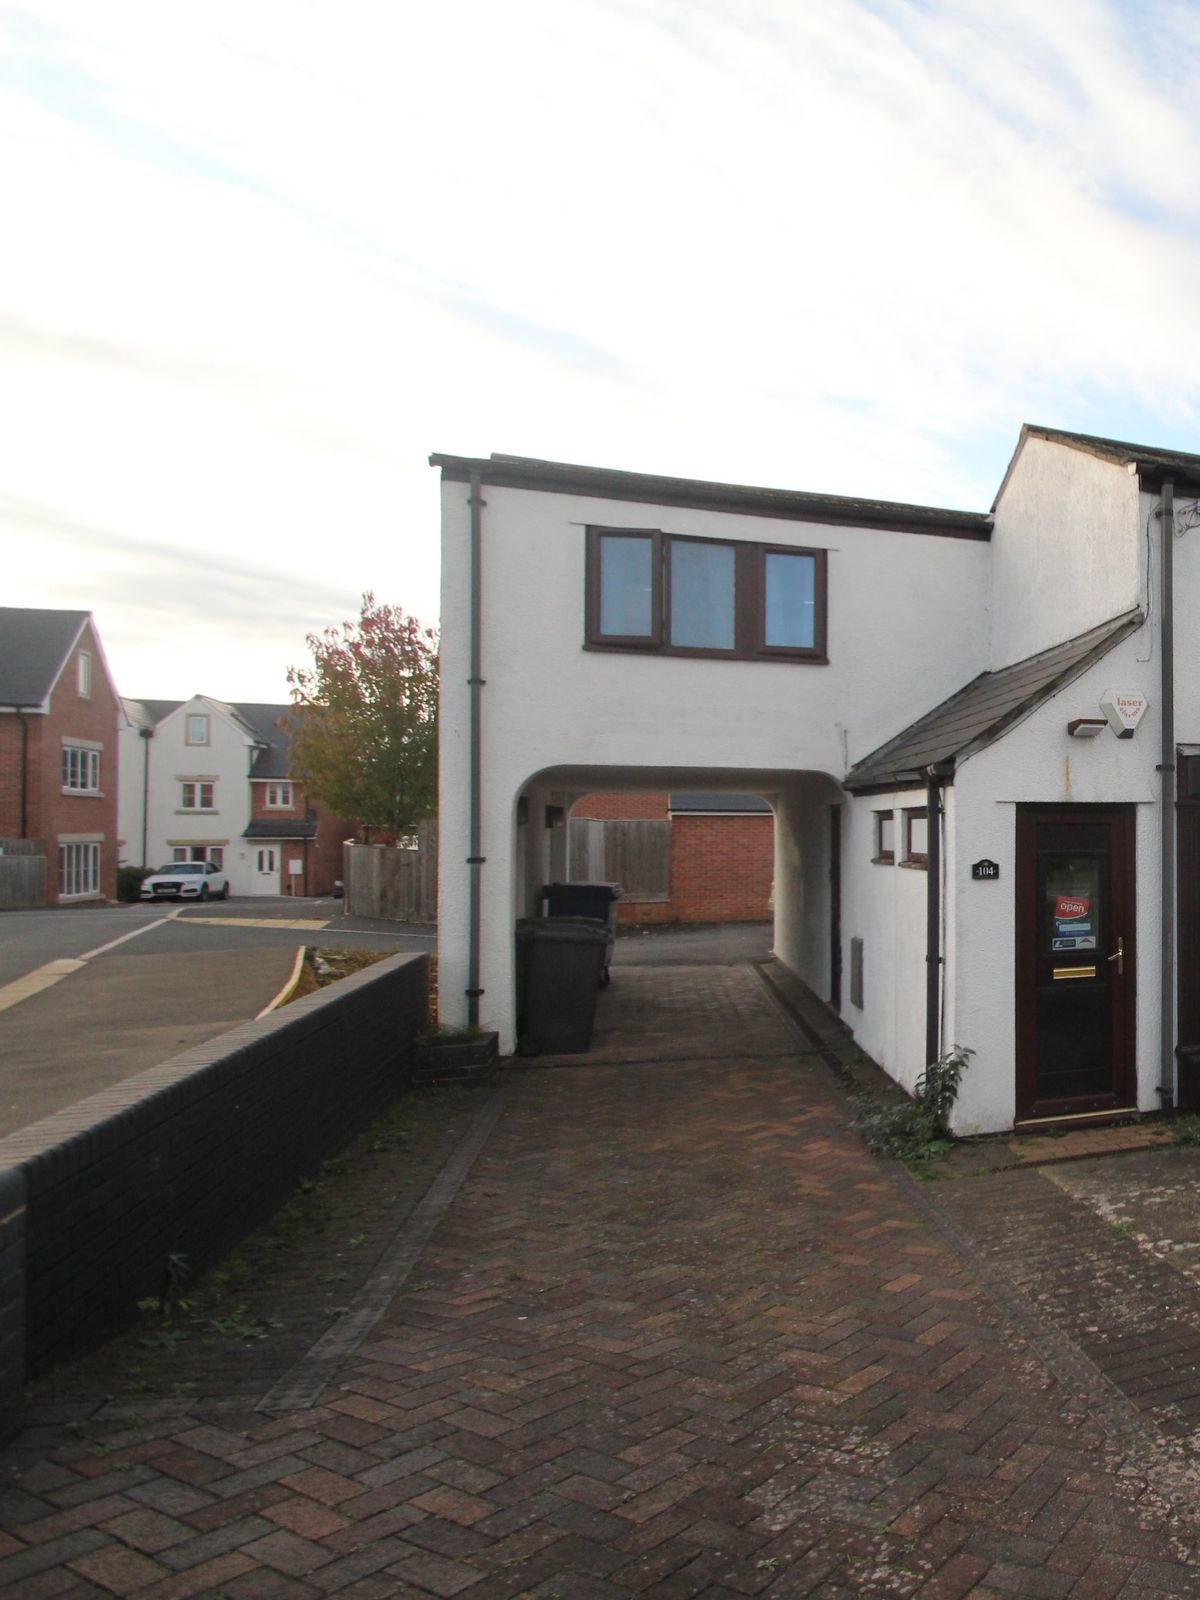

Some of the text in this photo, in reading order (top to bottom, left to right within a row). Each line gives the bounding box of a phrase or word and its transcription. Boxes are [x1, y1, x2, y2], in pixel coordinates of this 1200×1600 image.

[1117, 697, 1143, 707] laser
[979, 866, 994, 876] 104
[1060, 903, 1085, 912] open
